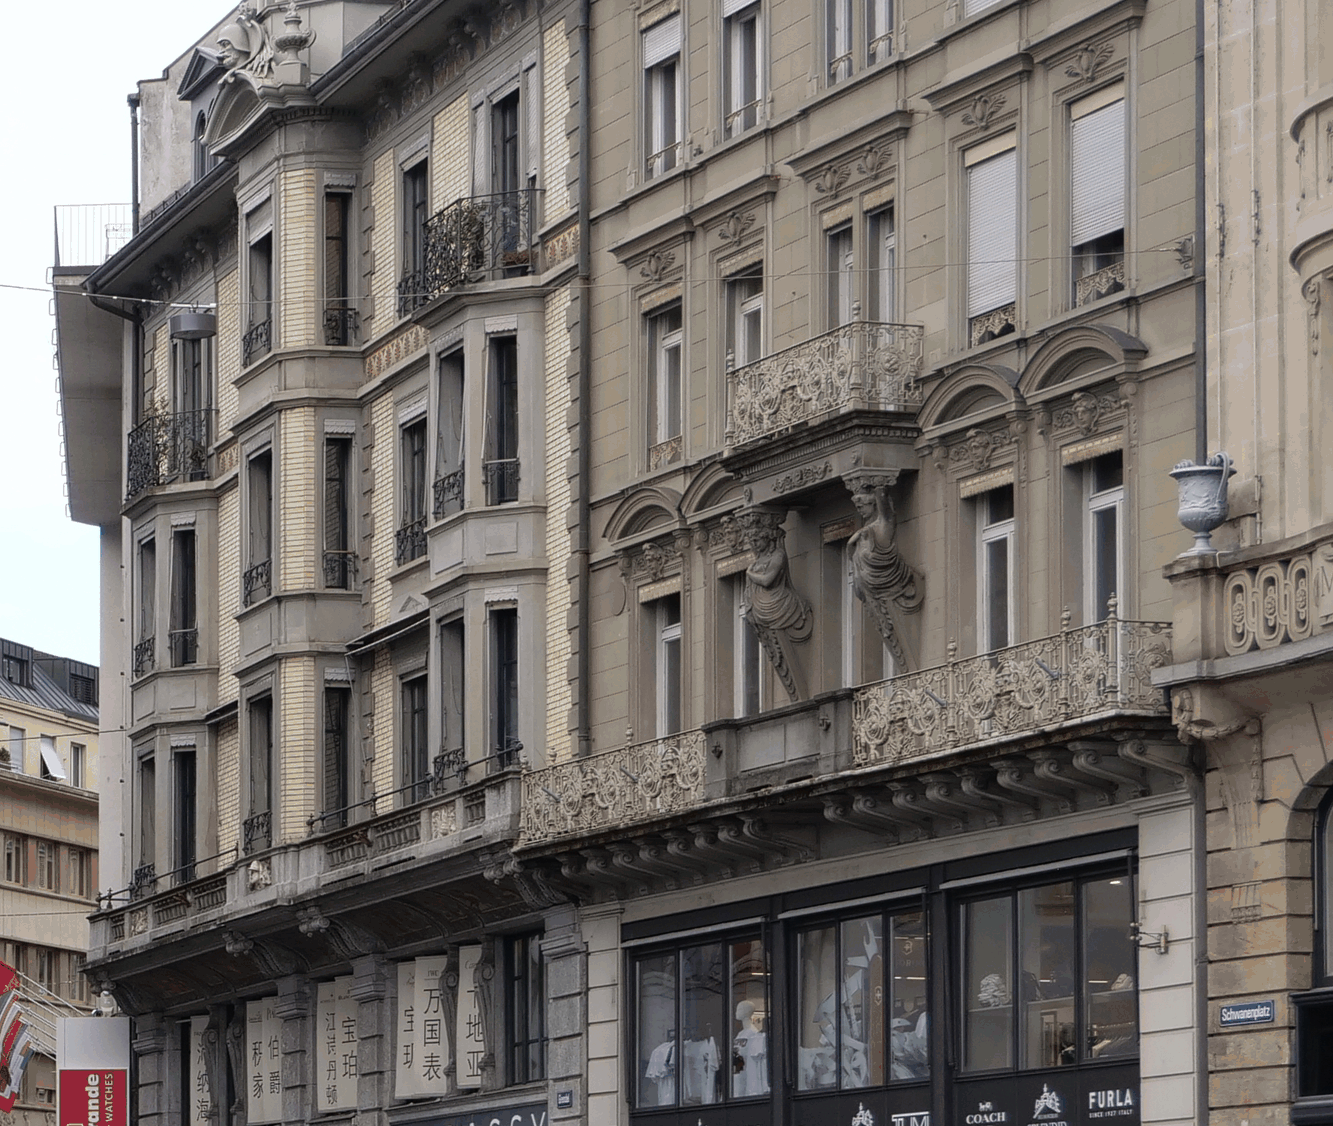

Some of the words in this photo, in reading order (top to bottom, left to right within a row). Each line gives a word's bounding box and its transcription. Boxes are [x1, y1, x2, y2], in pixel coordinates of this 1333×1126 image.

[423, 988, 442, 1082] 万国表
[1221, 1005, 1271, 1021] Schwanenplatz
[267, 1035, 281, 1096] 伯爵
[341, 1016, 358, 1080] 宝珀
[104, 1073, 114, 1123] WATCHES
[966, 1111, 1006, 1125] COACH
[1088, 1088, 1133, 1110] FURLA
